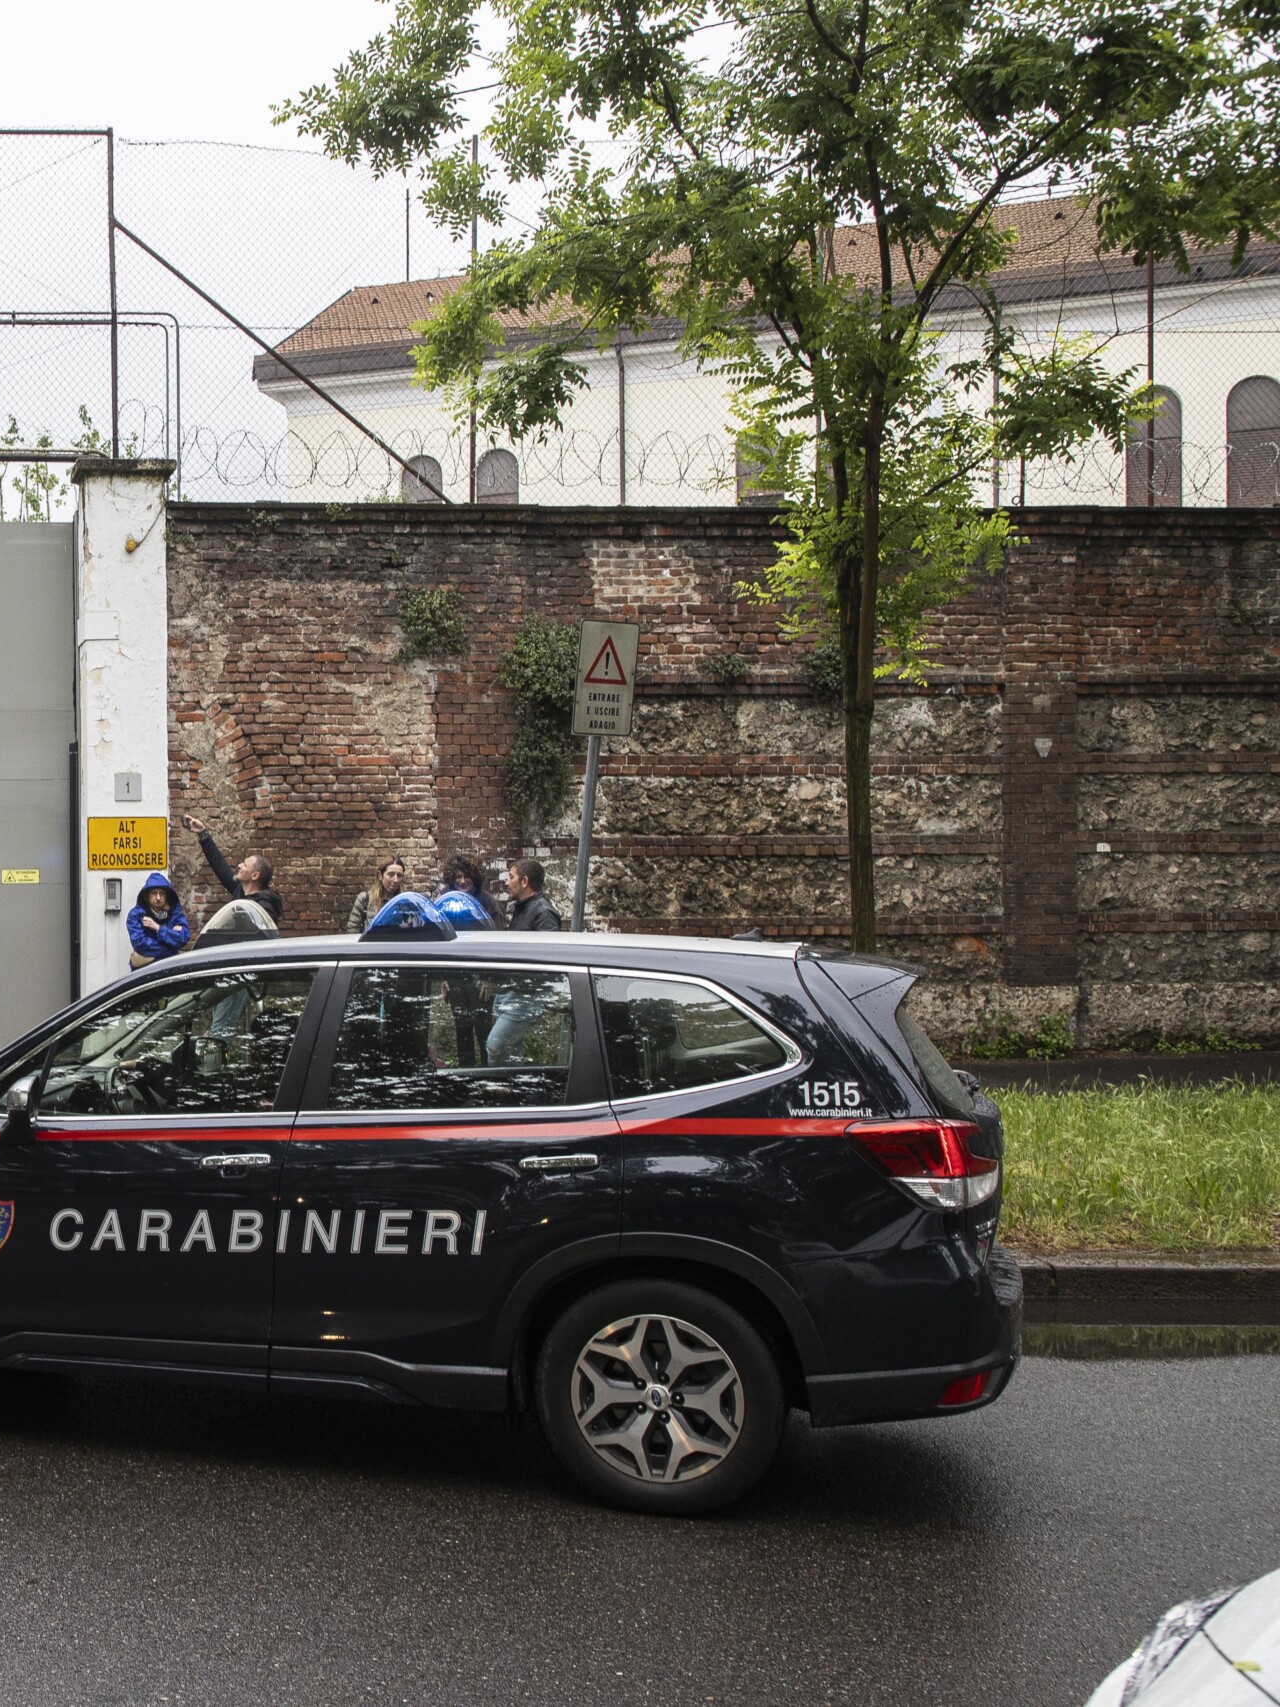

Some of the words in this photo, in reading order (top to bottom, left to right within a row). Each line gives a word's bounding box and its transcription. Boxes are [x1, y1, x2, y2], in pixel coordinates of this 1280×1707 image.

[588, 692, 620, 703] ENTRARE
[586, 706, 591, 715] E
[594, 706, 620, 717] USCIRE
[588, 720, 616, 730] ADAGIO
[125, 781, 130, 794] 1
[118, 820, 136, 833] ALT
[113, 837, 142, 850] FARSI
[91, 853, 164, 866] RICONOSCERE
[798, 1081, 860, 1107] 1515
[789, 1107, 873, 1117] www.carabinieri.it
[49, 1209, 487, 1255] CARABINIERI
